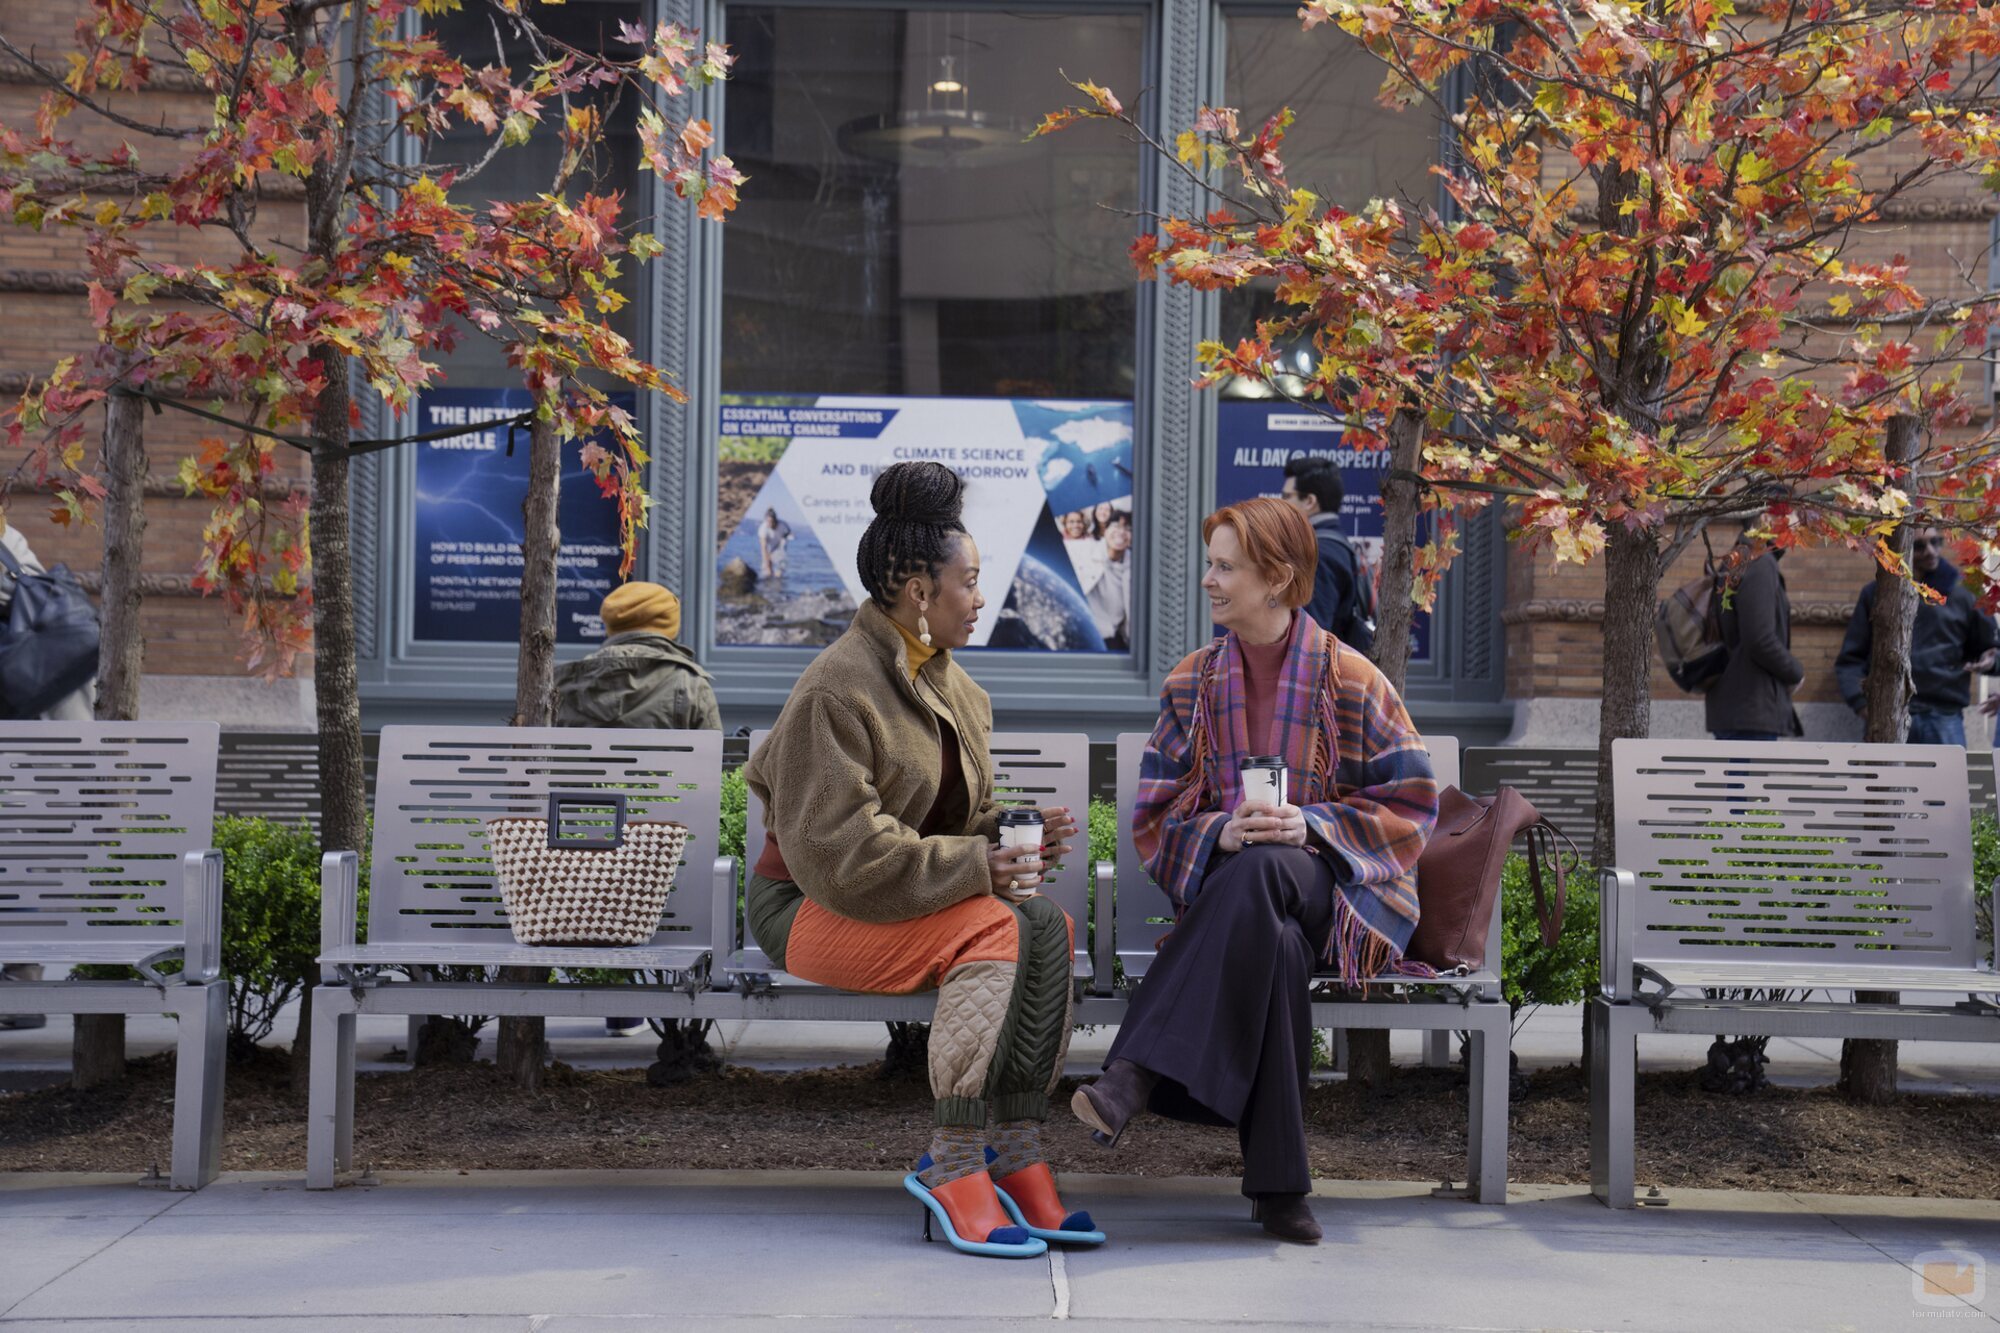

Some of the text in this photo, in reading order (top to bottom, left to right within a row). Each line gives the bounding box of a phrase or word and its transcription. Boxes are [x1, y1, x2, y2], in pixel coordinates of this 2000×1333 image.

[429, 406, 466, 425] THE
[722, 408, 883, 423] ESSENTIAL CONVERSATIONS
[722, 423, 840, 436] ON CLIMATE CHANGE
[893, 447, 1025, 462] CLIMATE SCIENCE
[1233, 448, 1259, 467] ALL
[1262, 449, 1290, 467] DAY
[821, 464, 855, 476] AND
[802, 495, 850, 508] Careers
[818, 512, 842, 524] and
[431, 542, 457, 552] HOW
[459, 542, 474, 553] TO
[474, 542, 506, 554] BUILD
[560, 545, 619, 556] NETWORKS
[431, 554, 446, 565] OF
[447, 554, 481, 565] PEERS
[482, 555, 506, 566] AND
[431, 575, 477, 587] MONTHLY
